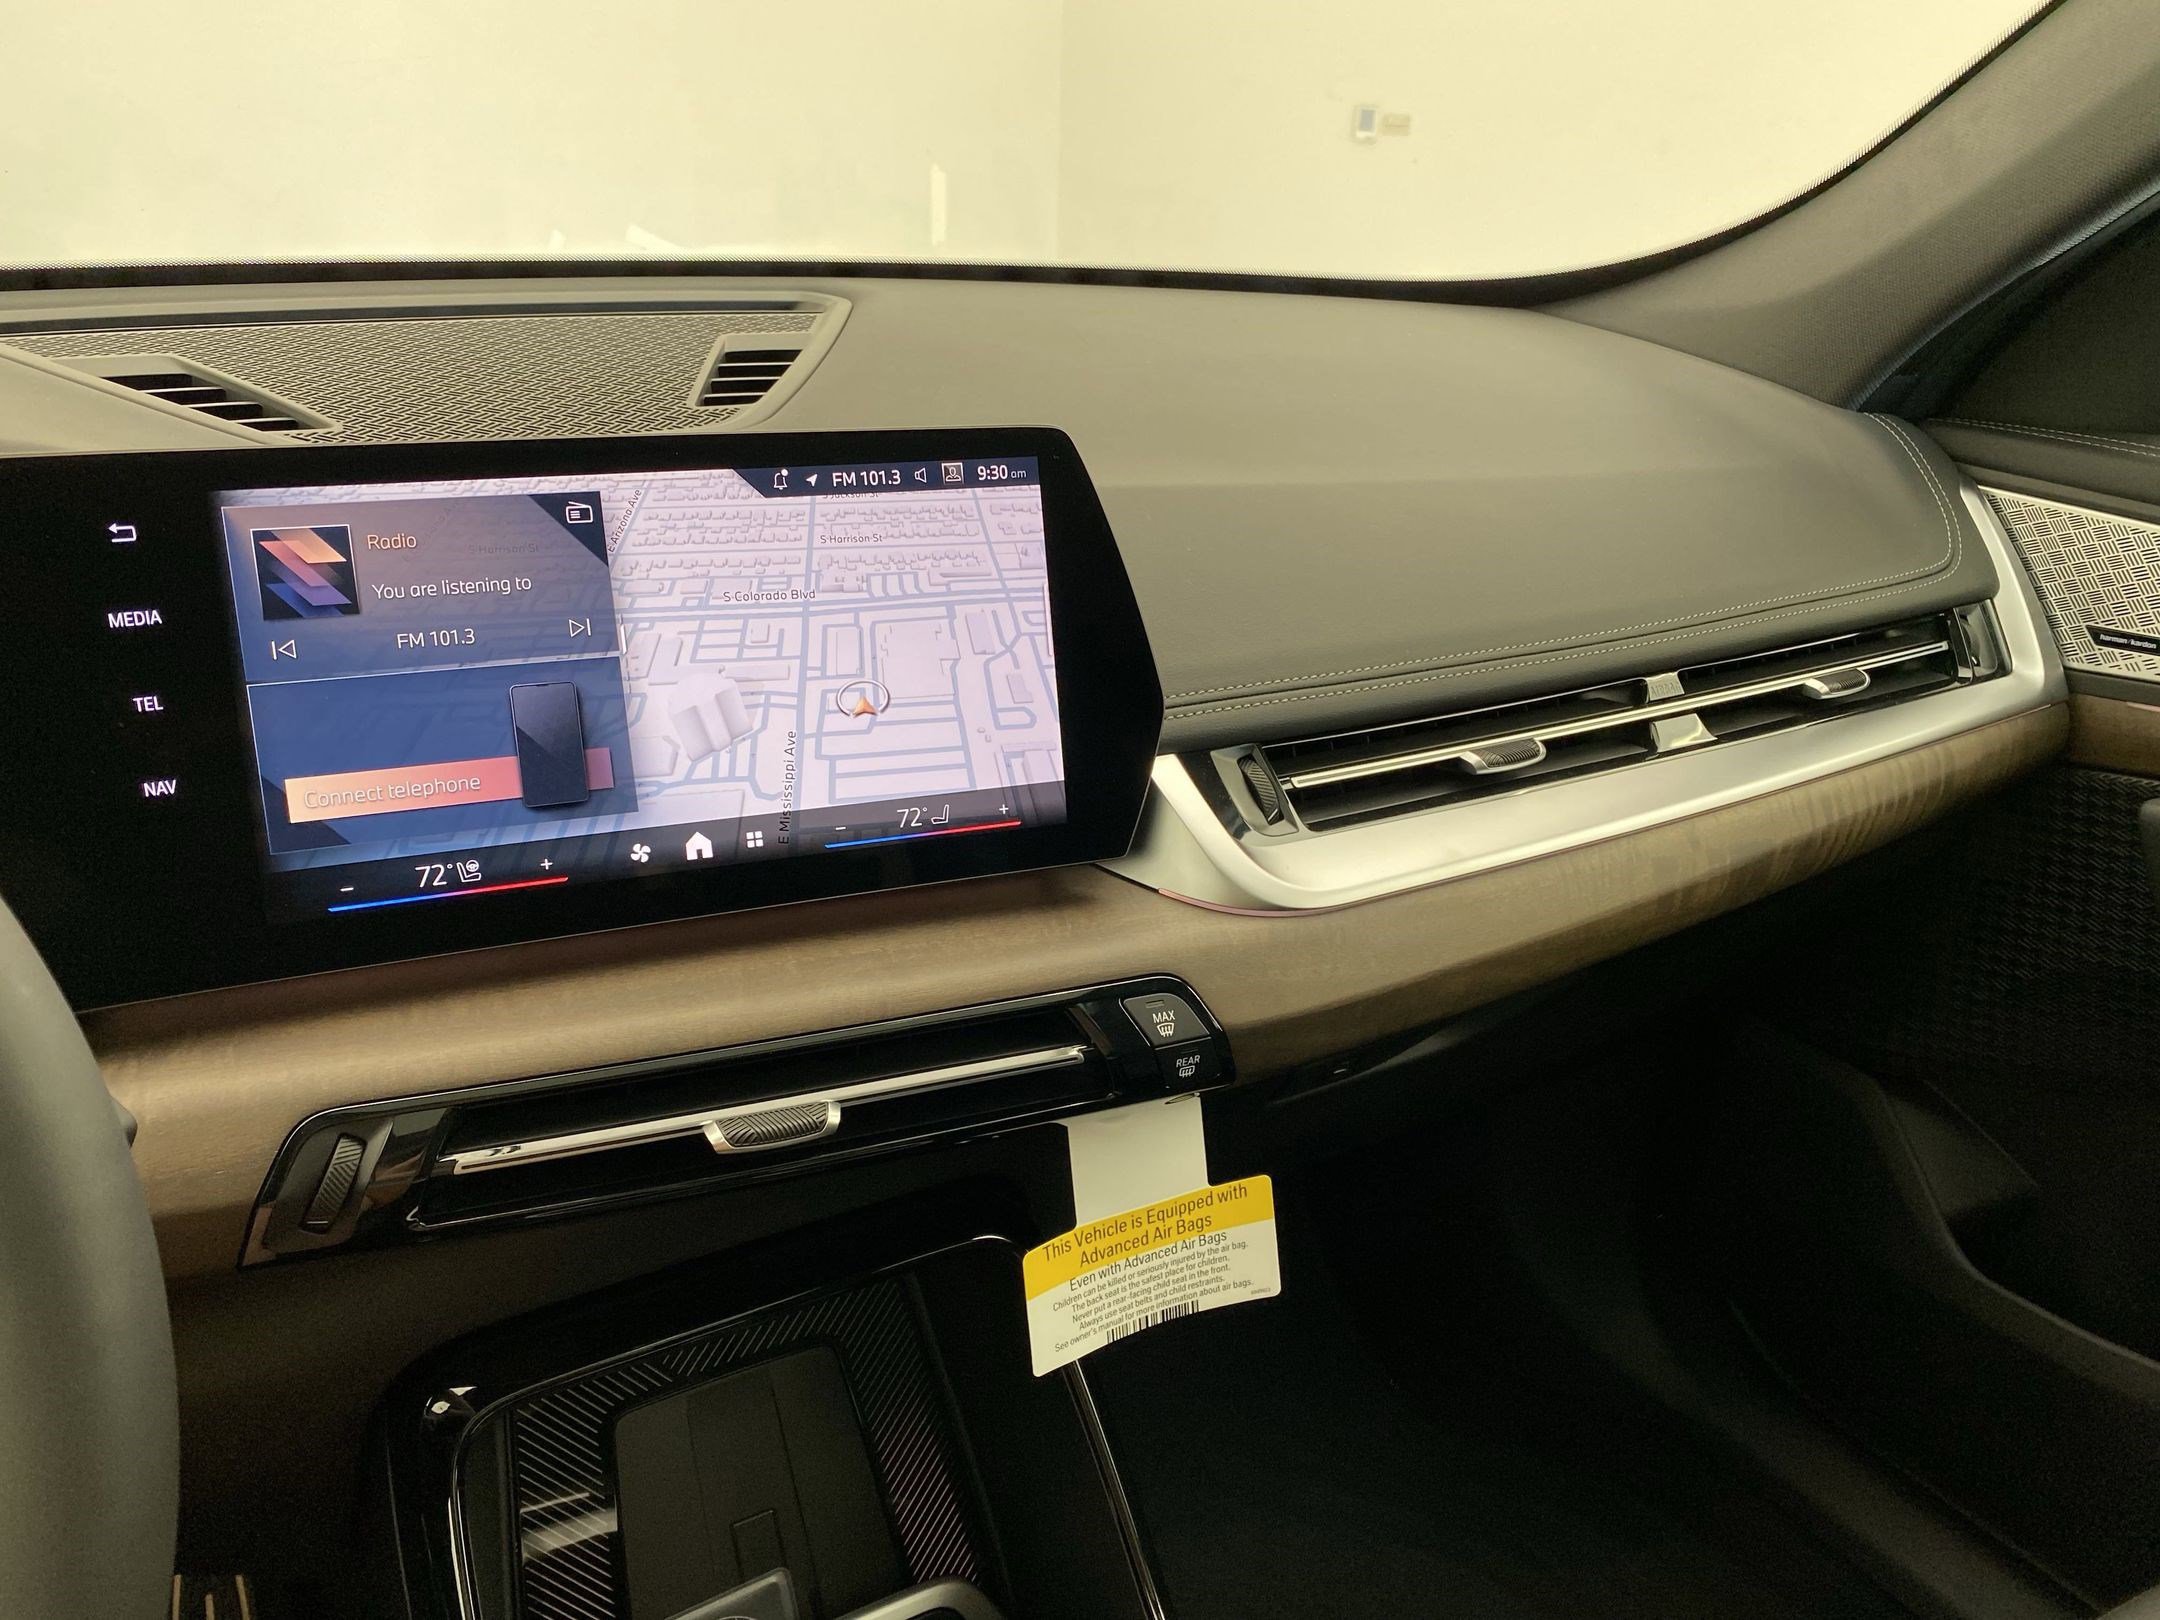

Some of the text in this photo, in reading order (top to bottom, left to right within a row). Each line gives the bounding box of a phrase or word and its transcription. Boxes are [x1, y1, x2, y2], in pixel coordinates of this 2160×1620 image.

[832, 470, 901, 487] FM 101.3
[977, 465, 1027, 480] 9:30 am
[610, 509, 632, 545] Arizona
[628, 489, 642, 508] Ave
[367, 531, 417, 551] Radio
[820, 534, 882, 543] S Harrison St
[372, 577, 532, 600] You are listening to
[723, 588, 816, 602] S Colorado Blvd
[107, 610, 163, 629] MEDIA
[397, 628, 476, 649] FM 101.3
[133, 696, 164, 712] TEL
[143, 779, 177, 797] NAV
[304, 774, 481, 809] Connect telephone
[778, 731, 797, 844] E Mississippi Ave
[897, 807, 928, 828] 72°
[416, 863, 453, 888] 72°
[1153, 1010, 1175, 1023] MAX
[1176, 1055, 1200, 1068] REAR
[1042, 1184, 1247, 1261] This Vehicle is Equipped with
[1080, 1215, 1212, 1267] Advanced Air Bags
[1070, 1231, 1227, 1291] Even with Advanced Air Bags
[1053, 1240, 1248, 1311] Children can be killed or seriously injured by the air bag.
[1072, 1304, 1085, 1313] The
[1087, 1295, 1103, 1307] back
[1105, 1289, 1119, 1299] seat
[1129, 1280, 1140, 1289] the
[1142, 1274, 1163, 1285] safest
[1165, 1267, 1184, 1278] place
[1186, 1263, 1196, 1271] for
[1198, 1256, 1230, 1268] children.
[1073, 1311, 1092, 1323] Never
[1094, 1304, 1105, 1315] put
[1113, 1286, 1152, 1306] rear-facing
[1153, 1279, 1170, 1291] child
[1172, 1276, 1187, 1286] seat
[1189, 1273, 1196, 1281] in
[1197, 1269, 1209, 1279] the
[1210, 1264, 1230, 1274] front.
[1079, 1276, 1225, 1331] Always use seat belts and child restraints.
[1055, 1279, 1254, 1352] See owner's manual for more information about air bags.
